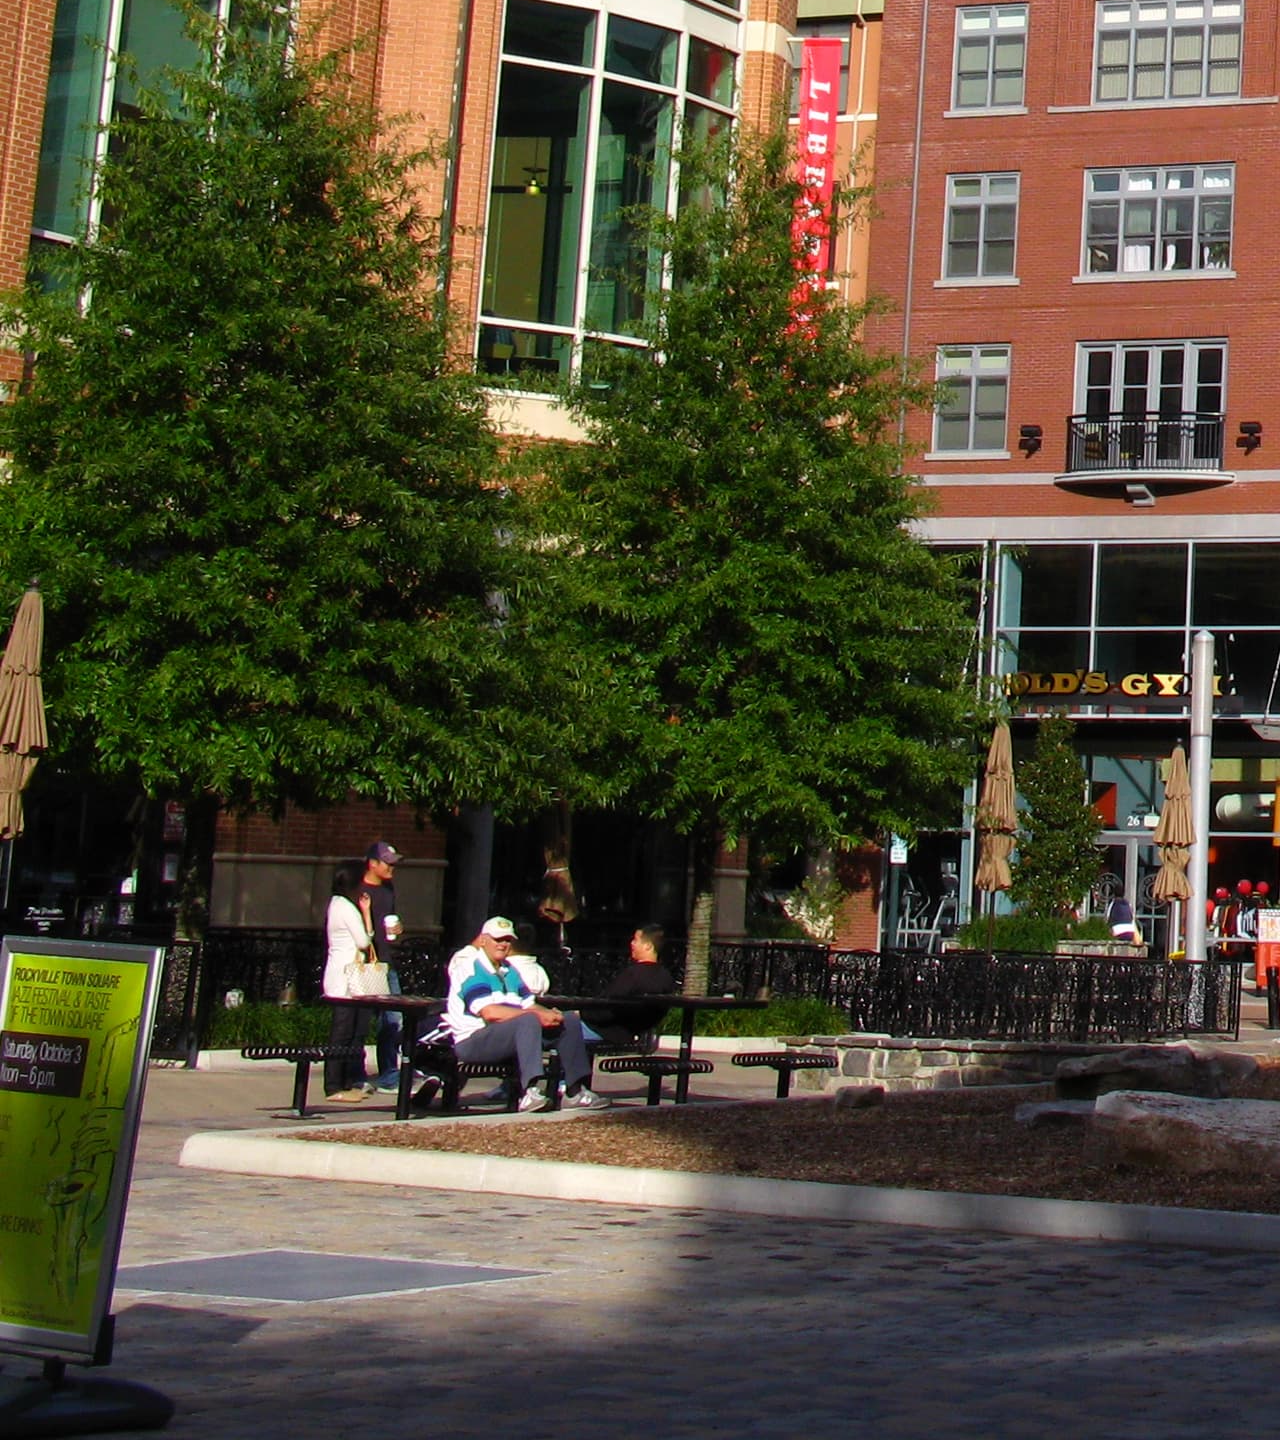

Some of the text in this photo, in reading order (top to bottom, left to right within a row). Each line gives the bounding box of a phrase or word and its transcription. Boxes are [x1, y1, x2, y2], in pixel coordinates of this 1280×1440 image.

[1003, 669, 1109, 696] OLD'S
[1127, 815, 1140, 827] 26
[15, 967, 122, 989] ROCKVILLE TOWN SQUARE
[32, 986, 71, 1007] FESTIVAL
[73, 990, 82, 1008] &
[85, 992, 112, 1010] TASTE
[21, 1006, 37, 1025] THE
[40, 1007, 65, 1028] TOWN
[66, 1010, 105, 1031] SQUARE
[4, 1037, 83, 1064] Saturday, October 3
